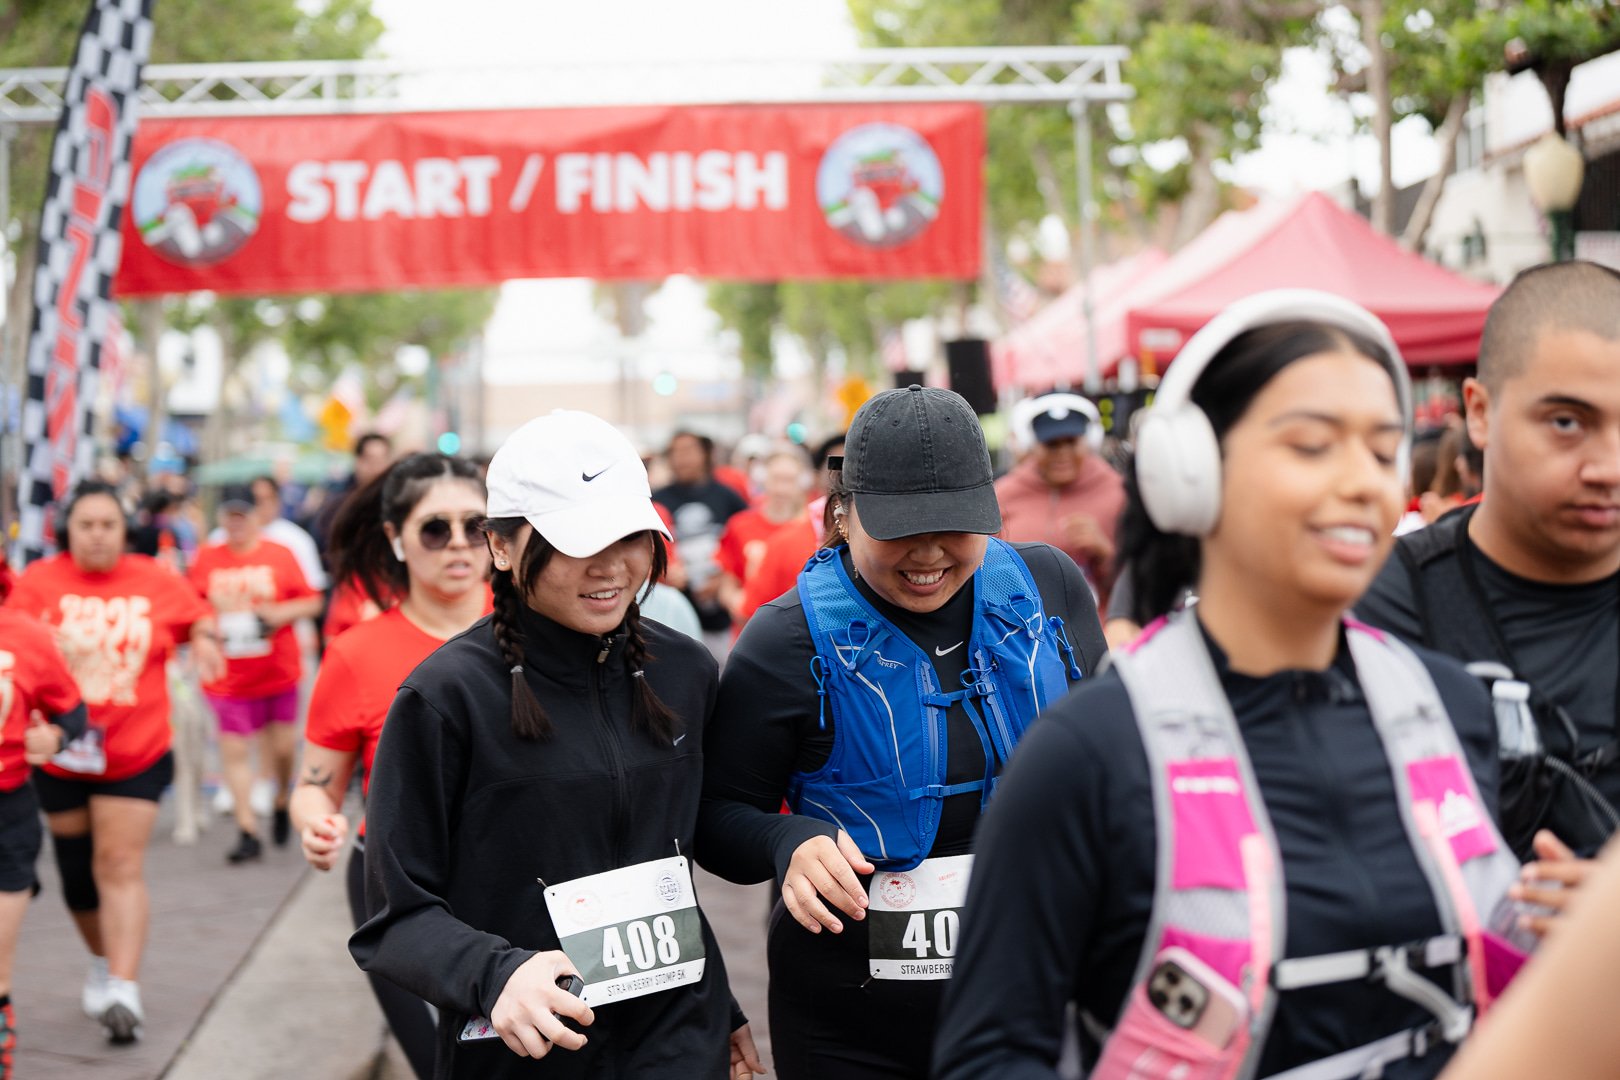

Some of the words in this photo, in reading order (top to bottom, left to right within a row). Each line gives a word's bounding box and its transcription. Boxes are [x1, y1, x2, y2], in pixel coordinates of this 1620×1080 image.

[287, 157, 500, 223] START
[555, 149, 789, 213] FINISH
[602, 915, 680, 975] 408
[902, 910, 961, 958] 40
[607, 977, 653, 996] STRAWBERRY
[655, 970, 676, 985] STOMP
[677, 969, 686, 980] 5K
